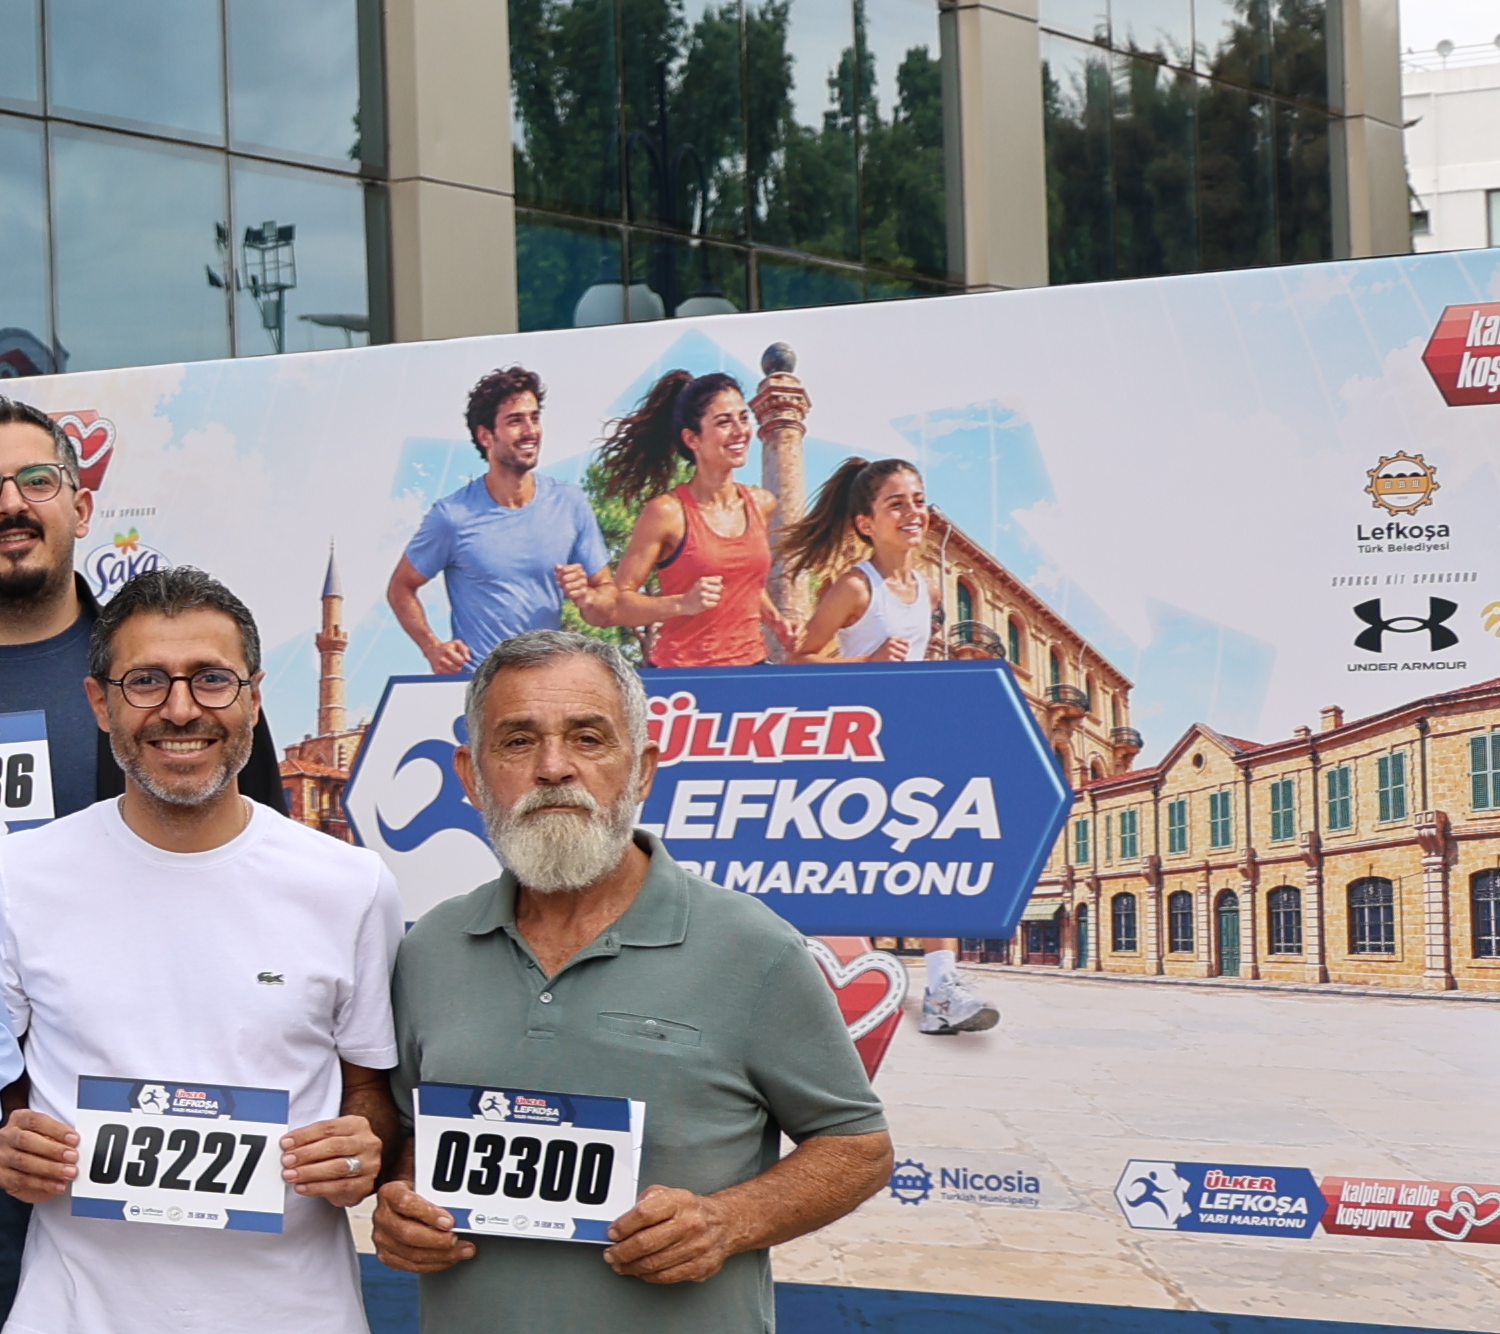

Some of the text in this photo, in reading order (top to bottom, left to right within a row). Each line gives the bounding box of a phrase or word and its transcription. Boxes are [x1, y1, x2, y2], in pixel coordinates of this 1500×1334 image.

[1465, 310, 1500, 348] ka
[1356, 522, 1451, 542] Lefkoşa
[1357, 541, 1451, 554] Türk Belediyesi
[1347, 660, 1467, 673] UNDER ARMOUR
[722, 860, 994, 896] MARATONU
[89, 1123, 268, 1195] 03227
[431, 1130, 615, 1205] 03300
[940, 1167, 1040, 1194] Nicosia
[1204, 1170, 1277, 1192] ÜLKER
[1340, 1180, 1440, 1207] kalpten kalbe
[941, 1192, 1040, 1207] Turkish Municipality
[1199, 1191, 1308, 1216] LEFKOŞA
[1198, 1213, 1306, 1229] YARI MARATONU
[1335, 1205, 1414, 1232] koşuyoruz
